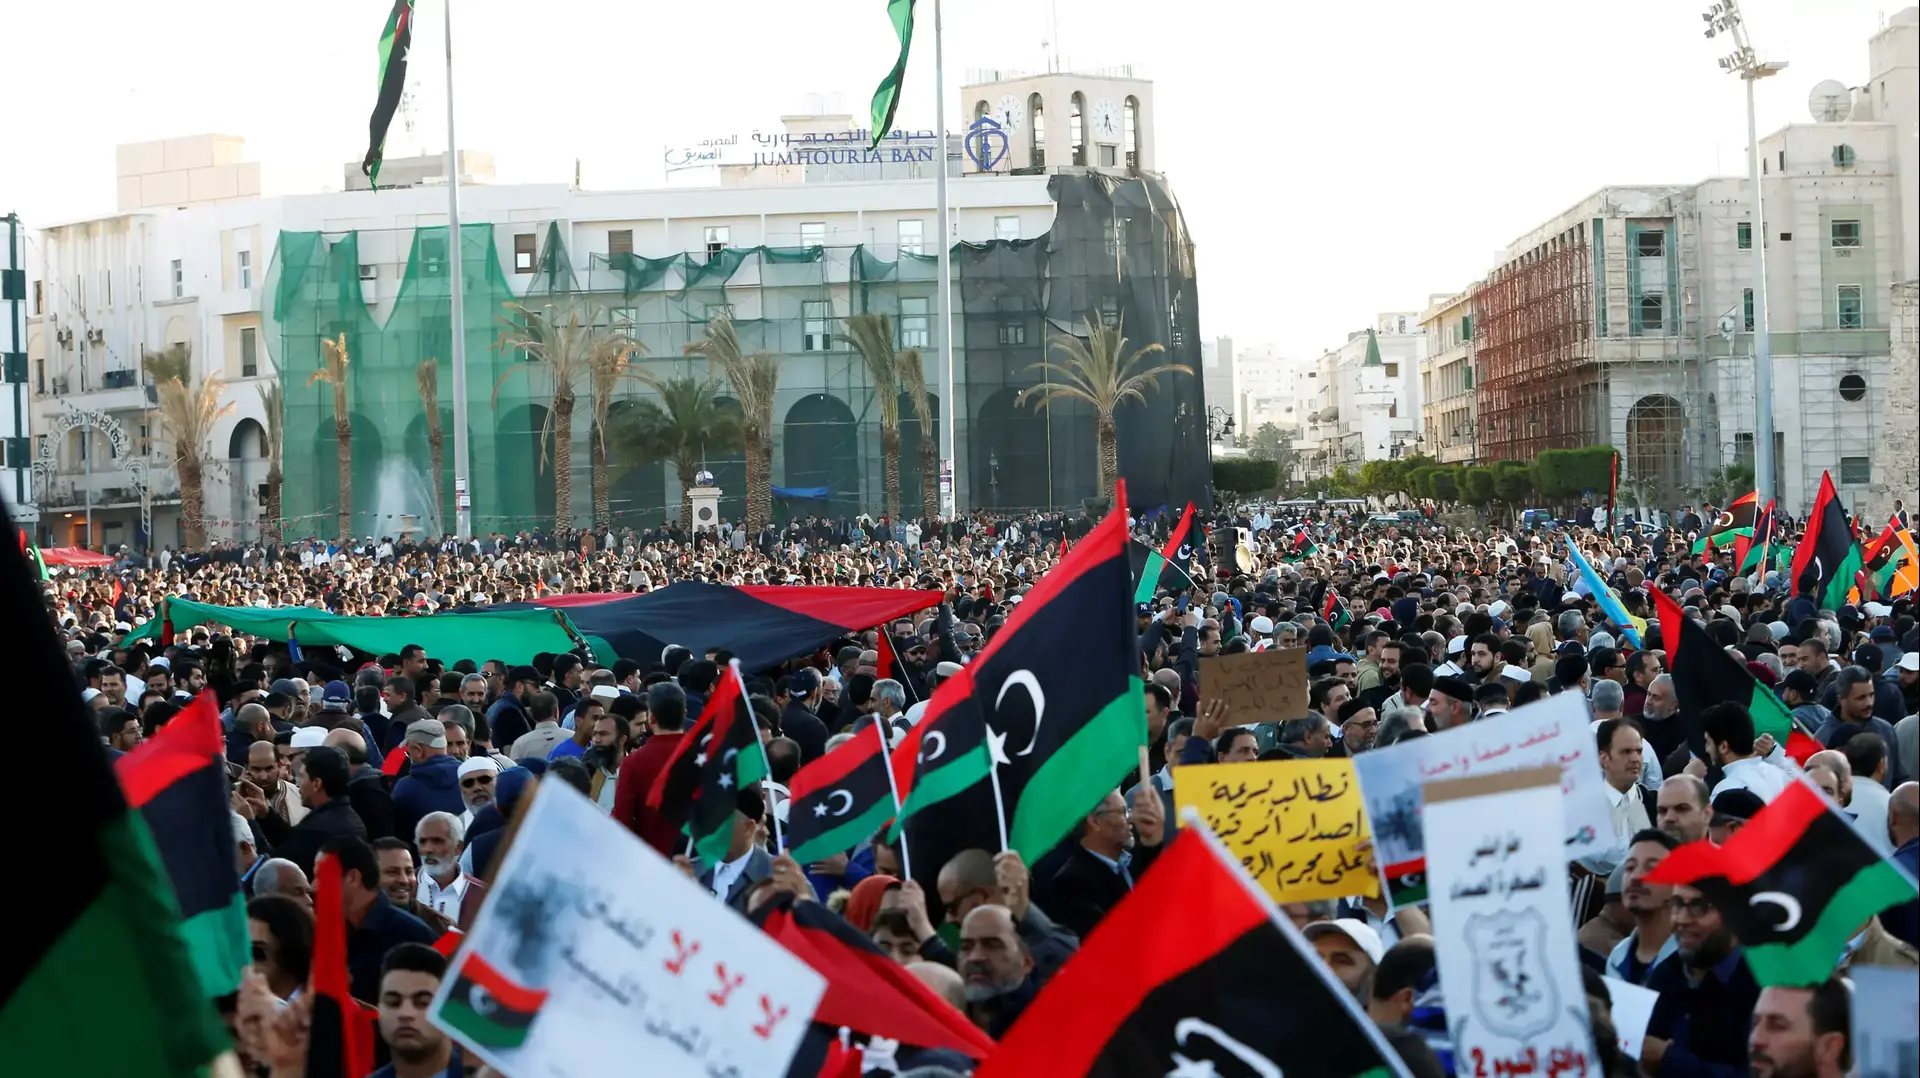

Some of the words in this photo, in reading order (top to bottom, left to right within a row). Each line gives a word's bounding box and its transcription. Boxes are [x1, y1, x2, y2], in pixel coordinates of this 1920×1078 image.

[751, 129, 867, 148] الجمهورية
[752, 147, 883, 168] JUMHOURIA
[891, 146, 934, 164] BAN
[1210, 779, 1273, 808] بسرعة
[1287, 809, 1361, 843] اصدار
[1276, 852, 1325, 891] مجرم
[1317, 849, 1363, 885] على
